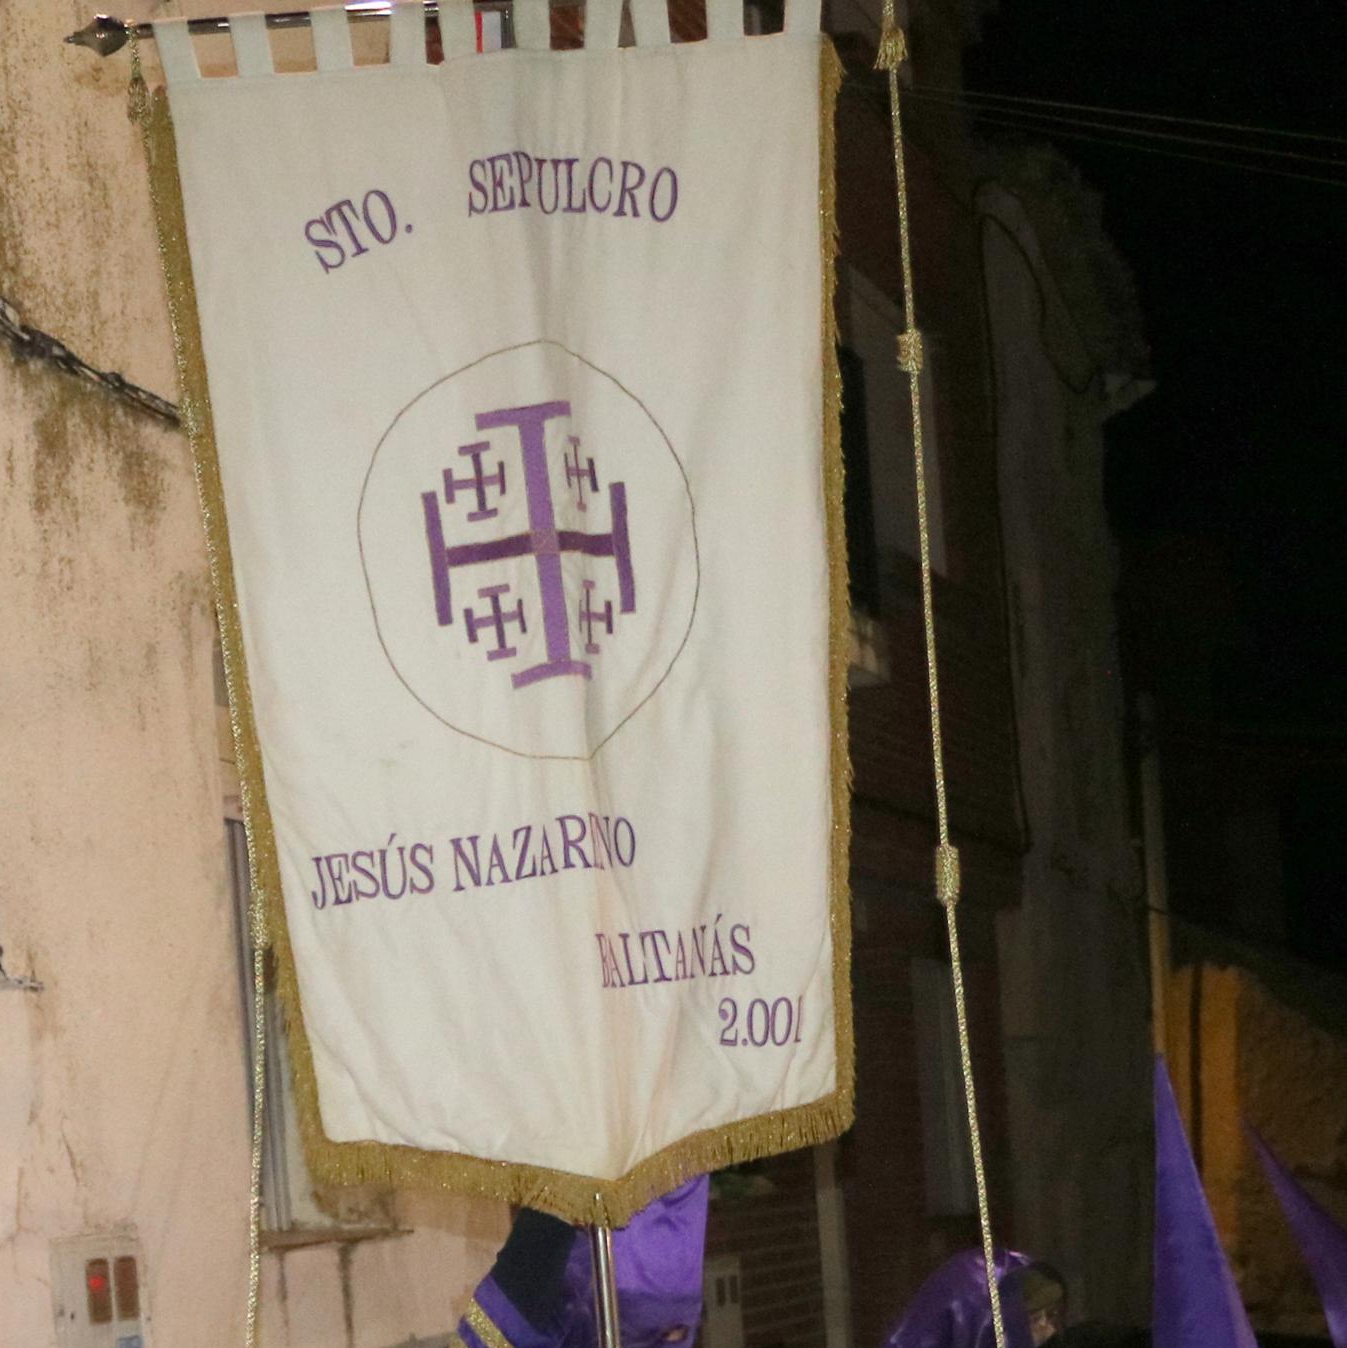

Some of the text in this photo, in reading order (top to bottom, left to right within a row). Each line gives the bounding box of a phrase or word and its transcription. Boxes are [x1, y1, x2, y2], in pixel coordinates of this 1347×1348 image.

[304, 152, 679, 274] STO. SEPULCRO
[311, 833, 434, 910] JESÚS
[595, 914, 755, 989] BALTANÁS
[717, 995, 803, 1048] 2.001
